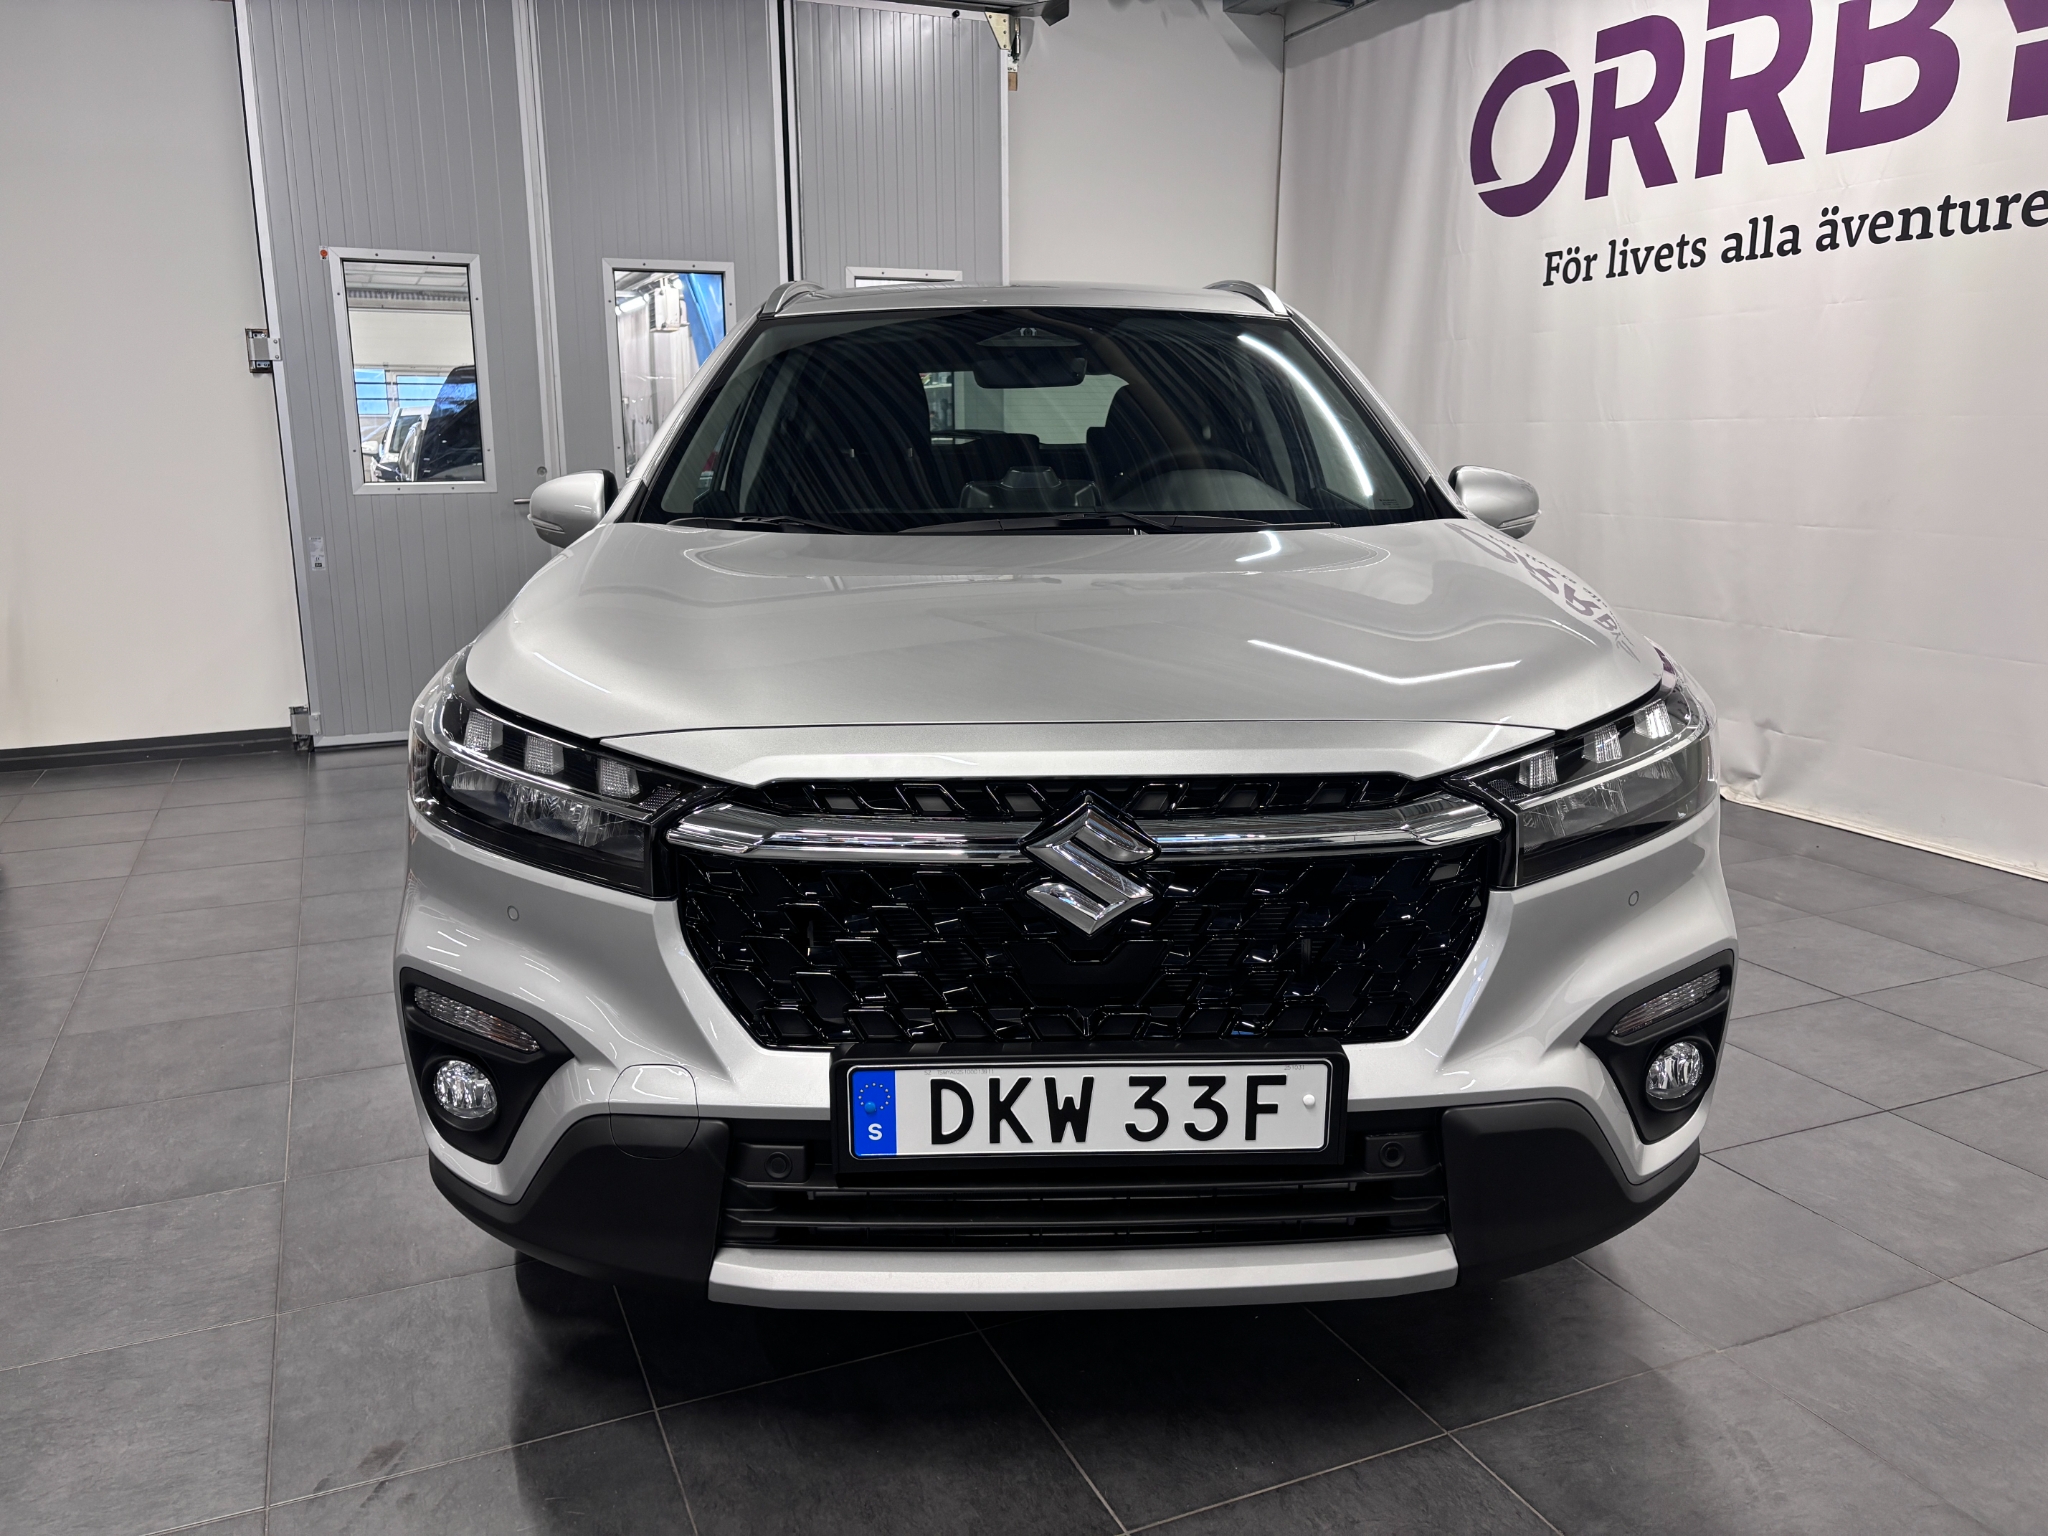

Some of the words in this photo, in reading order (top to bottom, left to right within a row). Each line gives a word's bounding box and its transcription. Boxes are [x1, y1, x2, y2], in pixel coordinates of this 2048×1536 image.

[1542, 245, 1598, 287] För
[1605, 233, 1707, 279] livets
[1720, 214, 1802, 264] alla
[1815, 189, 2048, 253] äventure
[867, 1122, 883, 1141] S
[929, 1076, 1095, 1145] DKW
[1124, 1074, 1288, 1142] 33F
